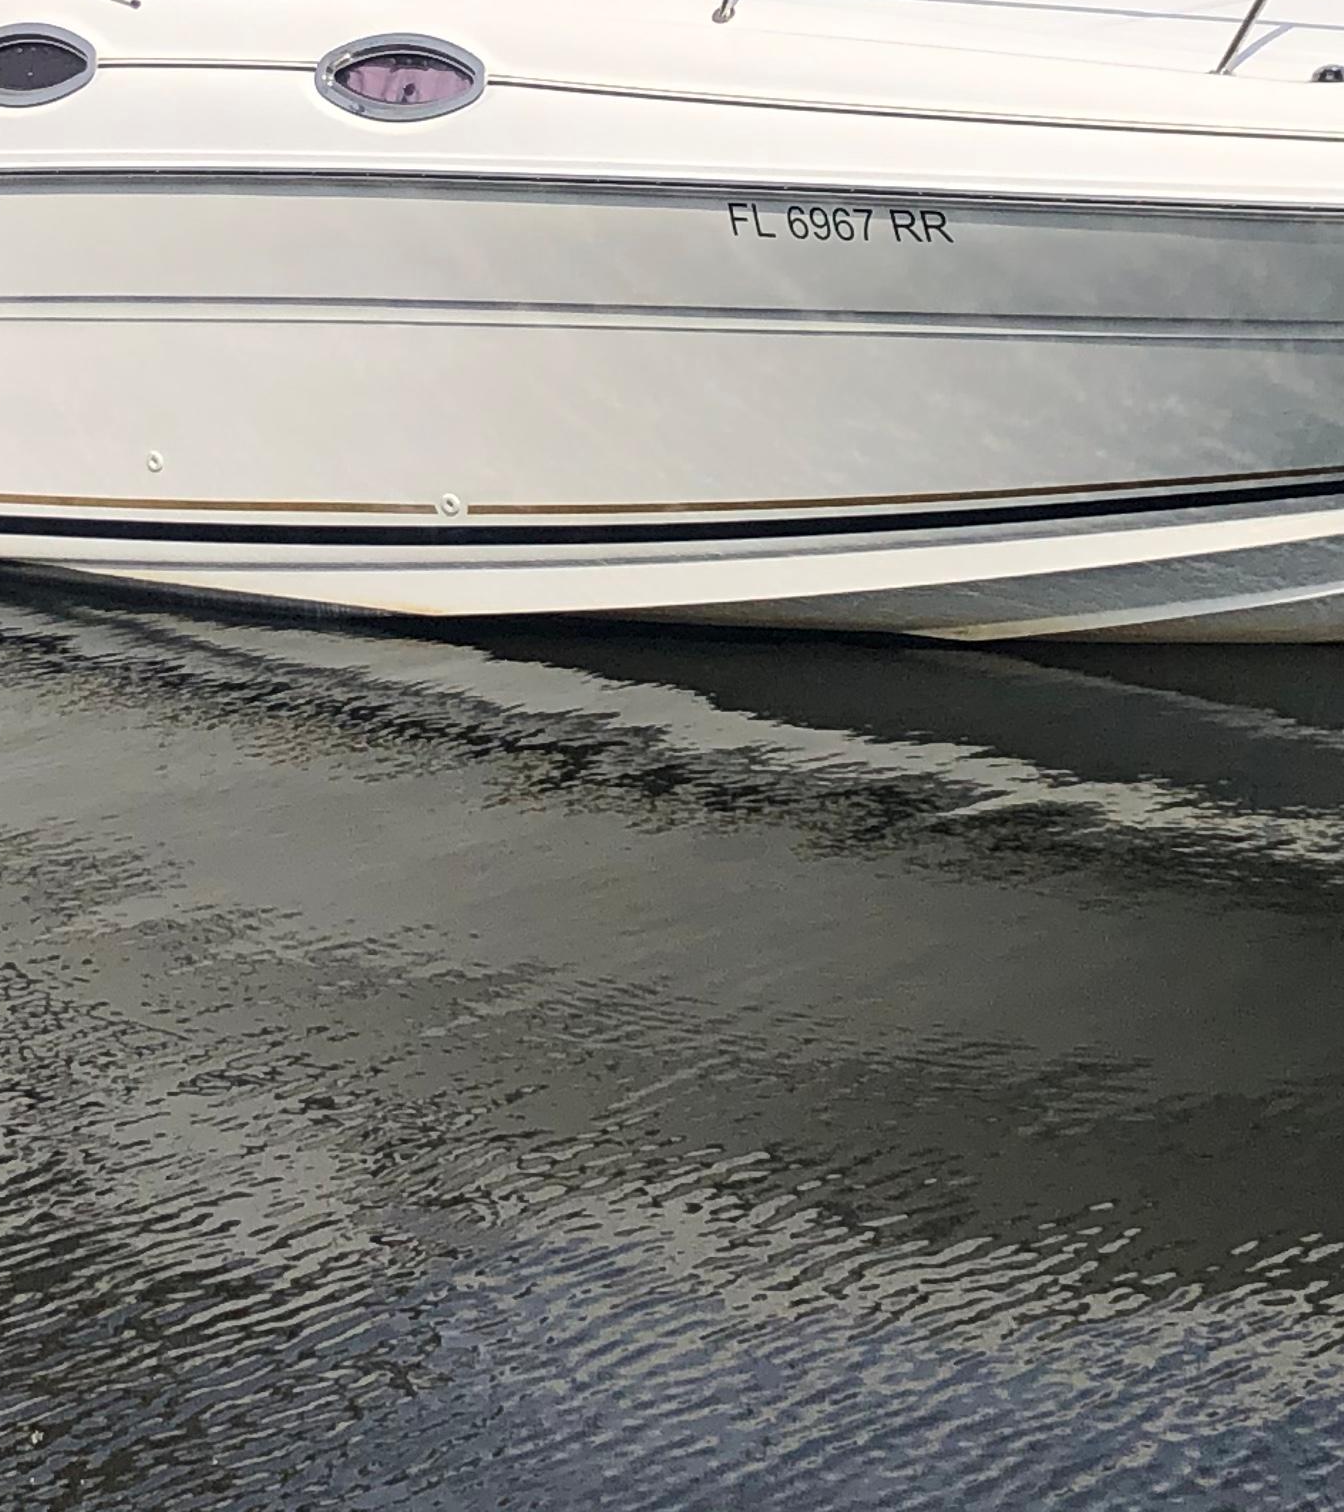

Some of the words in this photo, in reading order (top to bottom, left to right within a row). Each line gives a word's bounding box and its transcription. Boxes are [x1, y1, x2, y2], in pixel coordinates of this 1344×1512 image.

[728, 202, 777, 238] FL
[787, 205, 873, 241] 6967
[889, 209, 954, 244] RR
